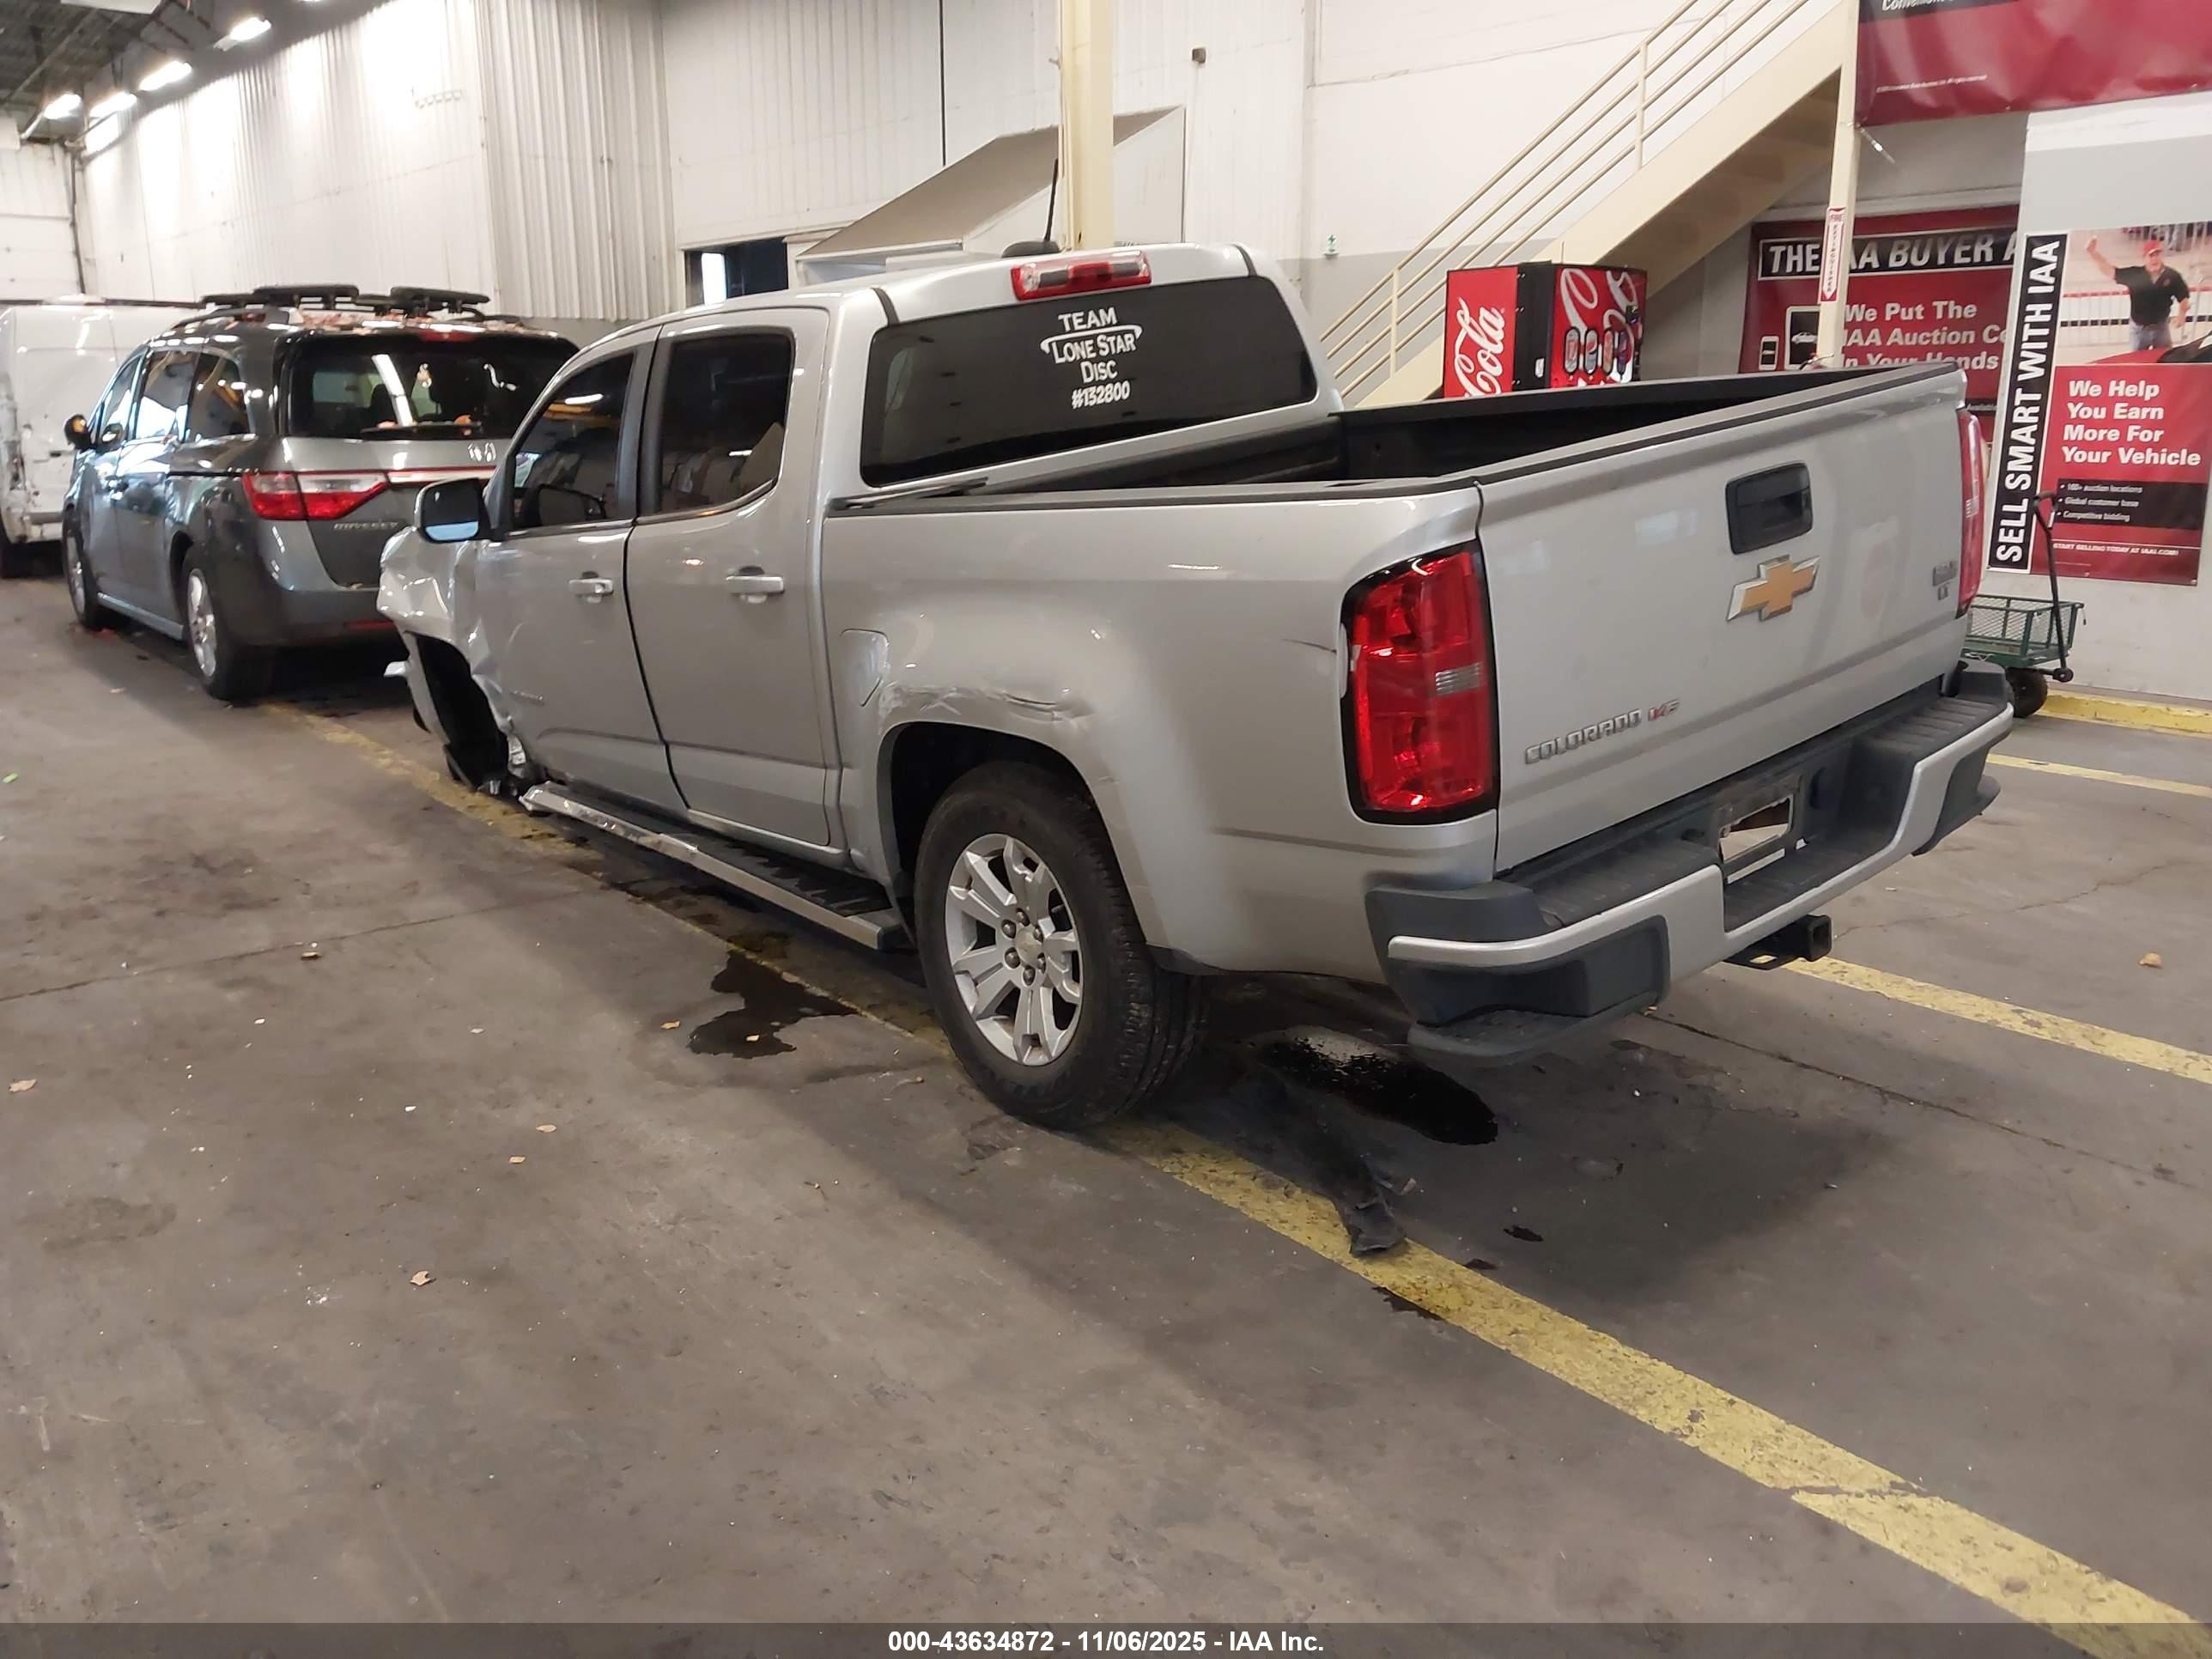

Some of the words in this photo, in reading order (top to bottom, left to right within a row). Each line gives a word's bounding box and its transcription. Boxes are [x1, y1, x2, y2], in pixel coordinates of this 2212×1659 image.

[1769, 244, 1820, 273] THE
[1888, 233, 1994, 268] BUYER
[2002, 230, 2018, 261] A
[2027, 240, 2060, 294] IAA
[1058, 307, 1117, 331] TEAM
[1845, 304, 1878, 322] We
[1885, 302, 1924, 321] Put
[1933, 300, 1977, 319] The
[1844, 328, 1882, 347] IAA
[1887, 326, 1975, 346] Auction
[1982, 324, 2008, 343] Co
[2017, 303, 2053, 381] WITH
[2069, 380, 2103, 398] We
[2108, 380, 2160, 401] Help
[2067, 402, 2107, 420] You
[2113, 402, 2165, 420] Earn
[2004, 387, 2042, 490] SMART
[2063, 424, 2121, 442] More
[2126, 425, 2165, 443] For
[2061, 447, 2112, 464] Your
[2118, 447, 2202, 466] Vehicle
[1996, 498, 2029, 562] SELL
[1525, 709, 1642, 763] COLORADO
